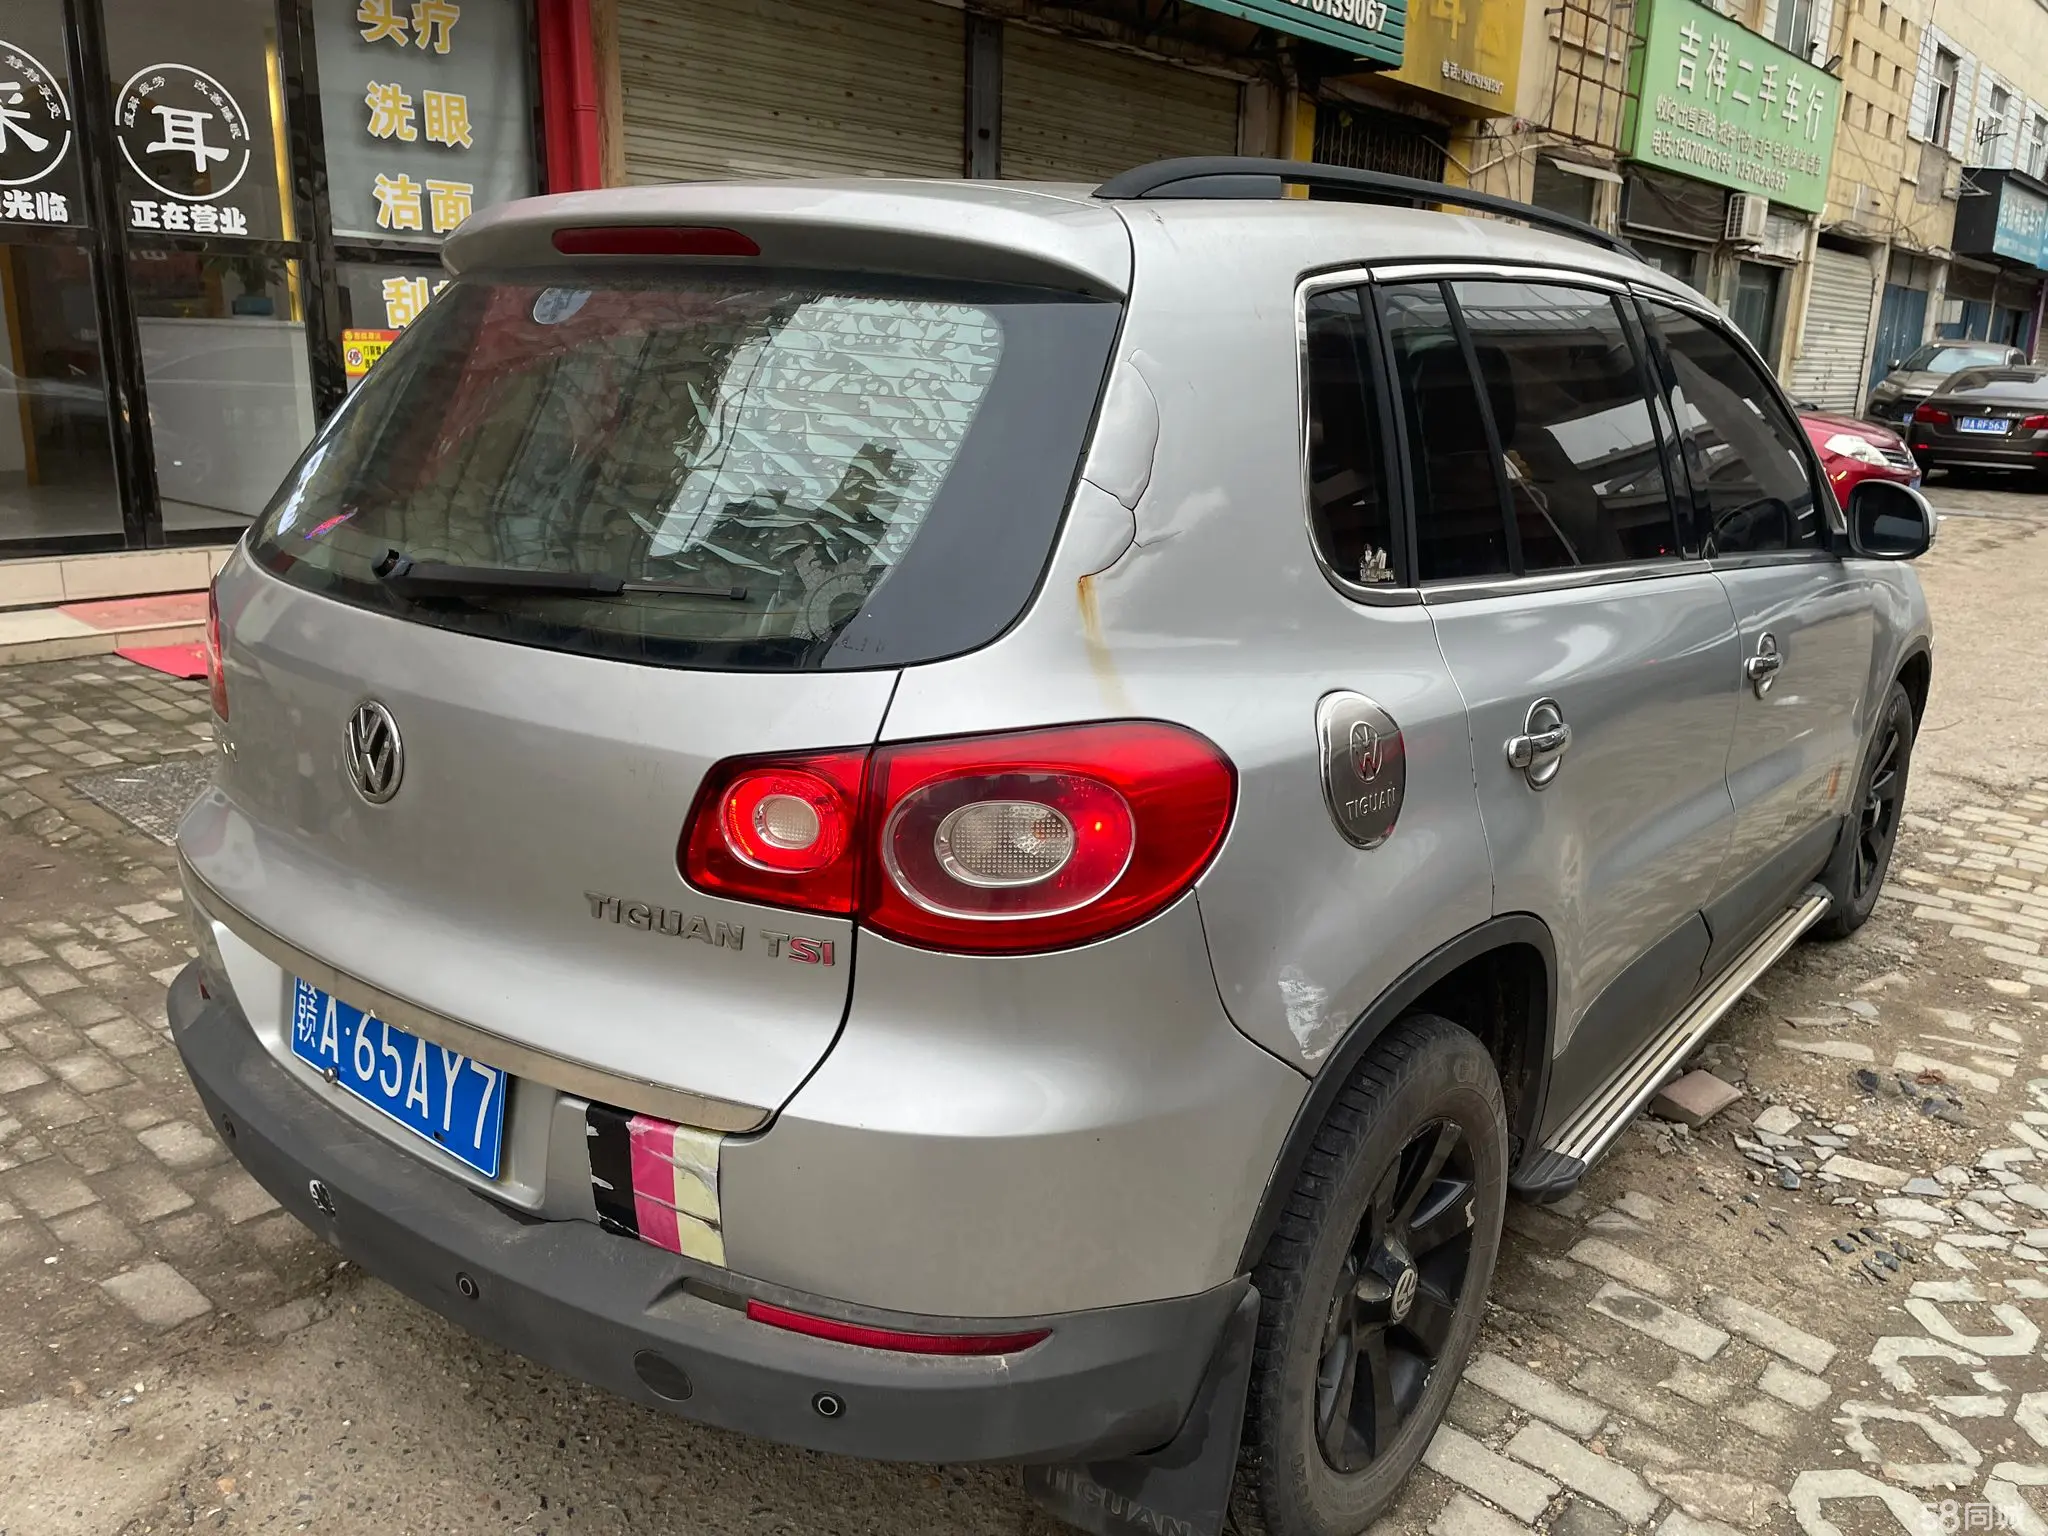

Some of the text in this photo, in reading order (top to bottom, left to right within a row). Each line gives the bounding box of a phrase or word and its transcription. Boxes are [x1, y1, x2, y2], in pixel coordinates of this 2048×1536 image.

[357, 0, 460, 54] 头疗
[1290, 0, 1388, 31] 139067
[1676, 19, 1825, 142] 吉祥二手车行
[194, 79, 242, 140] 改善睡眠
[365, 80, 473, 149] 洗眼
[146, 104, 229, 173] 耳
[0, 189, 68, 223] 光临
[130, 200, 248, 235] 正在营业
[373, 173, 473, 233] 洁面
[382, 276, 450, 329] 刮
[1345, 787, 1397, 821] TIGUAN
[583, 889, 835, 967] TIGUAN TSI
